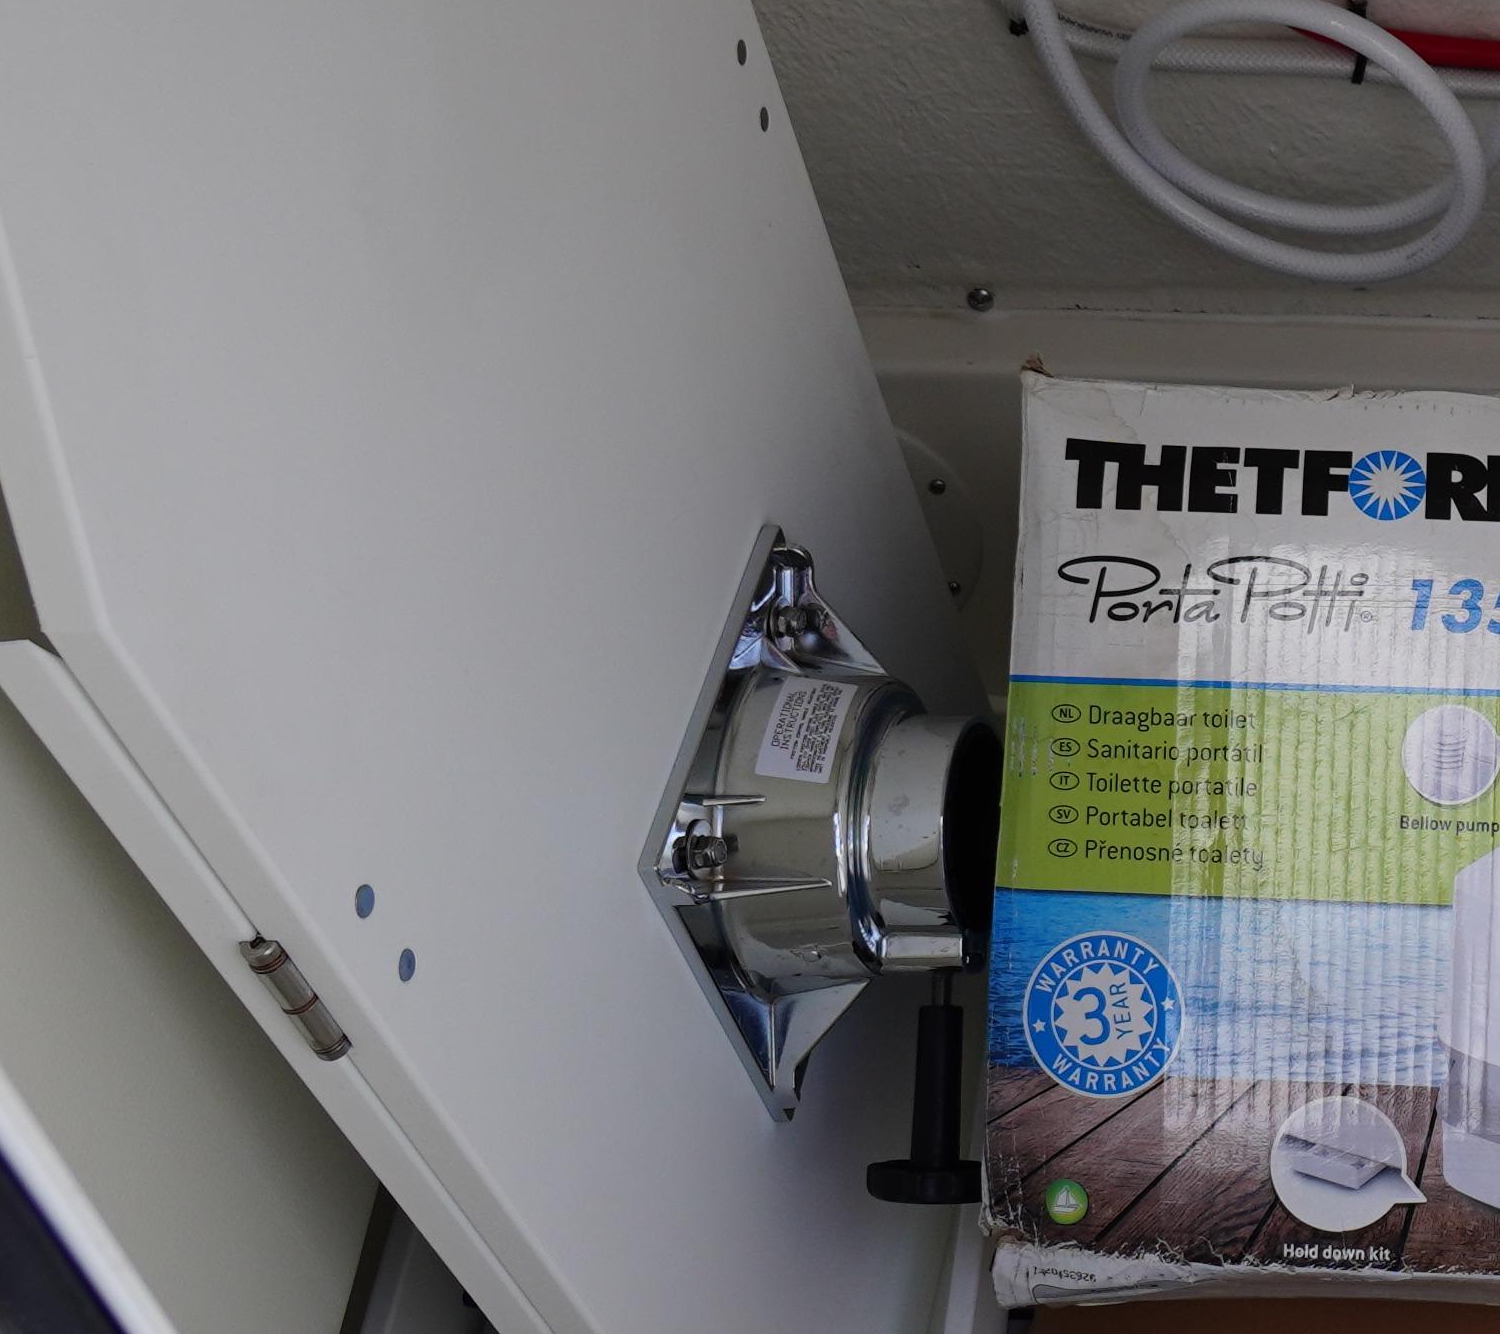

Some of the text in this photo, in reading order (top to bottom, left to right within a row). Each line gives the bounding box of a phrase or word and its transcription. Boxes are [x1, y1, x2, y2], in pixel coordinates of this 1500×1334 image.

[1058, 555, 1221, 624] Porta
[771, 691, 797, 747] OPERATIONAL
[780, 690, 807, 750] INSTRUCTIONS
[1059, 705, 1256, 732] NL Draagbaar toilet
[1059, 738, 1263, 767] ES Sanitario portátil
[1058, 772, 1258, 800] IT Toilette portatile
[1056, 806, 1247, 830] SV Portabel toalett
[1400, 815, 1500, 837] Bellow pump
[1056, 839, 1264, 871] CZ Přenosné toalety
[1035, 939, 1160, 994] WARRANTY
[1073, 982, 1133, 1045] 3 YEAR
[1051, 1037, 1171, 1092] WARRANTY
[1283, 1243, 1391, 1261] Hold down kit
